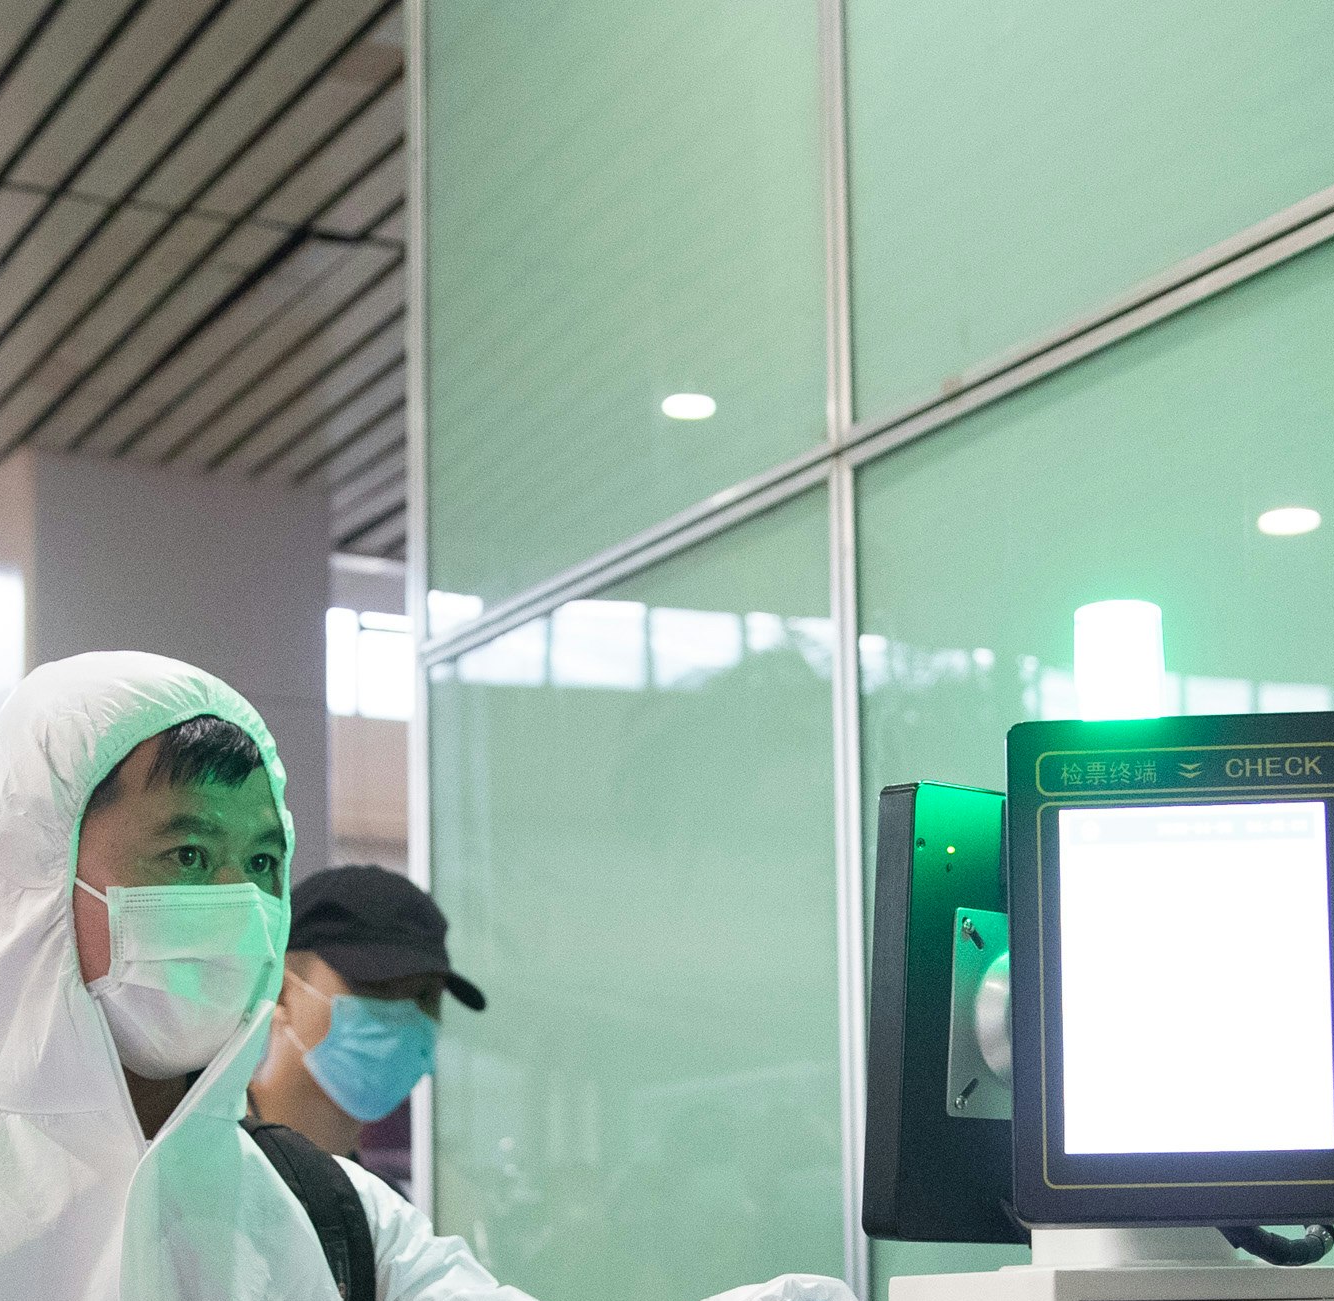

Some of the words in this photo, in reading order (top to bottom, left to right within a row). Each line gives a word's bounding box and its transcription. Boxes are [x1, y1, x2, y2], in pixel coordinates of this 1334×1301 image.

[1060, 759, 1157, 787] 检票终端
[1224, 755, 1323, 780] CHECK
